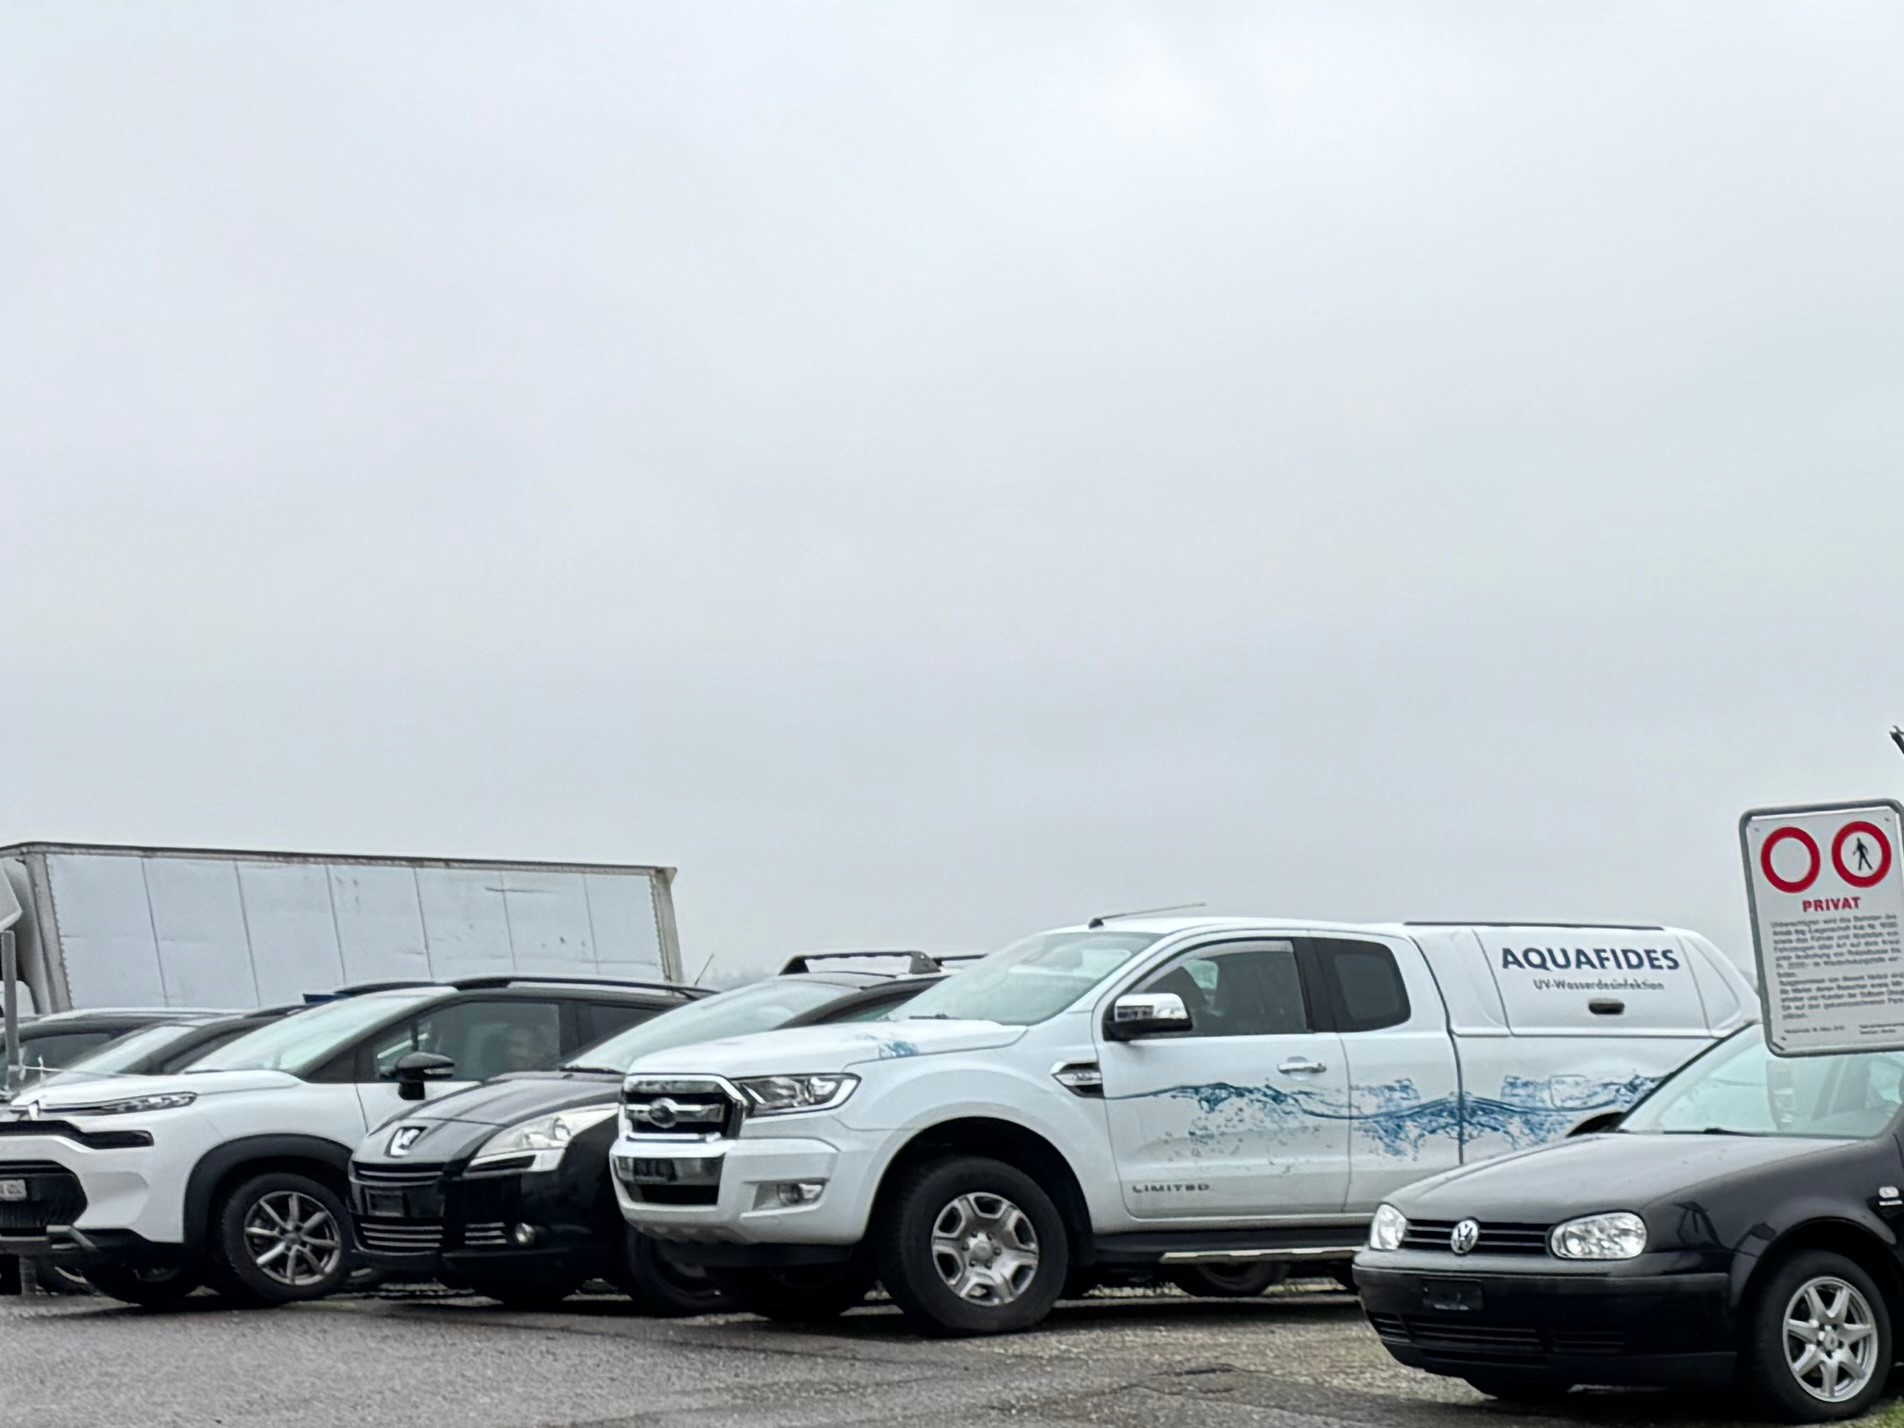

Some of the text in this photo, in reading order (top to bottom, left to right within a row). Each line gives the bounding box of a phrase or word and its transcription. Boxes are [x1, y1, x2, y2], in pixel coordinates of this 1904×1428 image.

[1803, 897, 1861, 912] PRIVAT
[1502, 948, 1679, 971] AQUAFIDES
[1533, 978, 1664, 990] UV-Wasserdesinfektion
